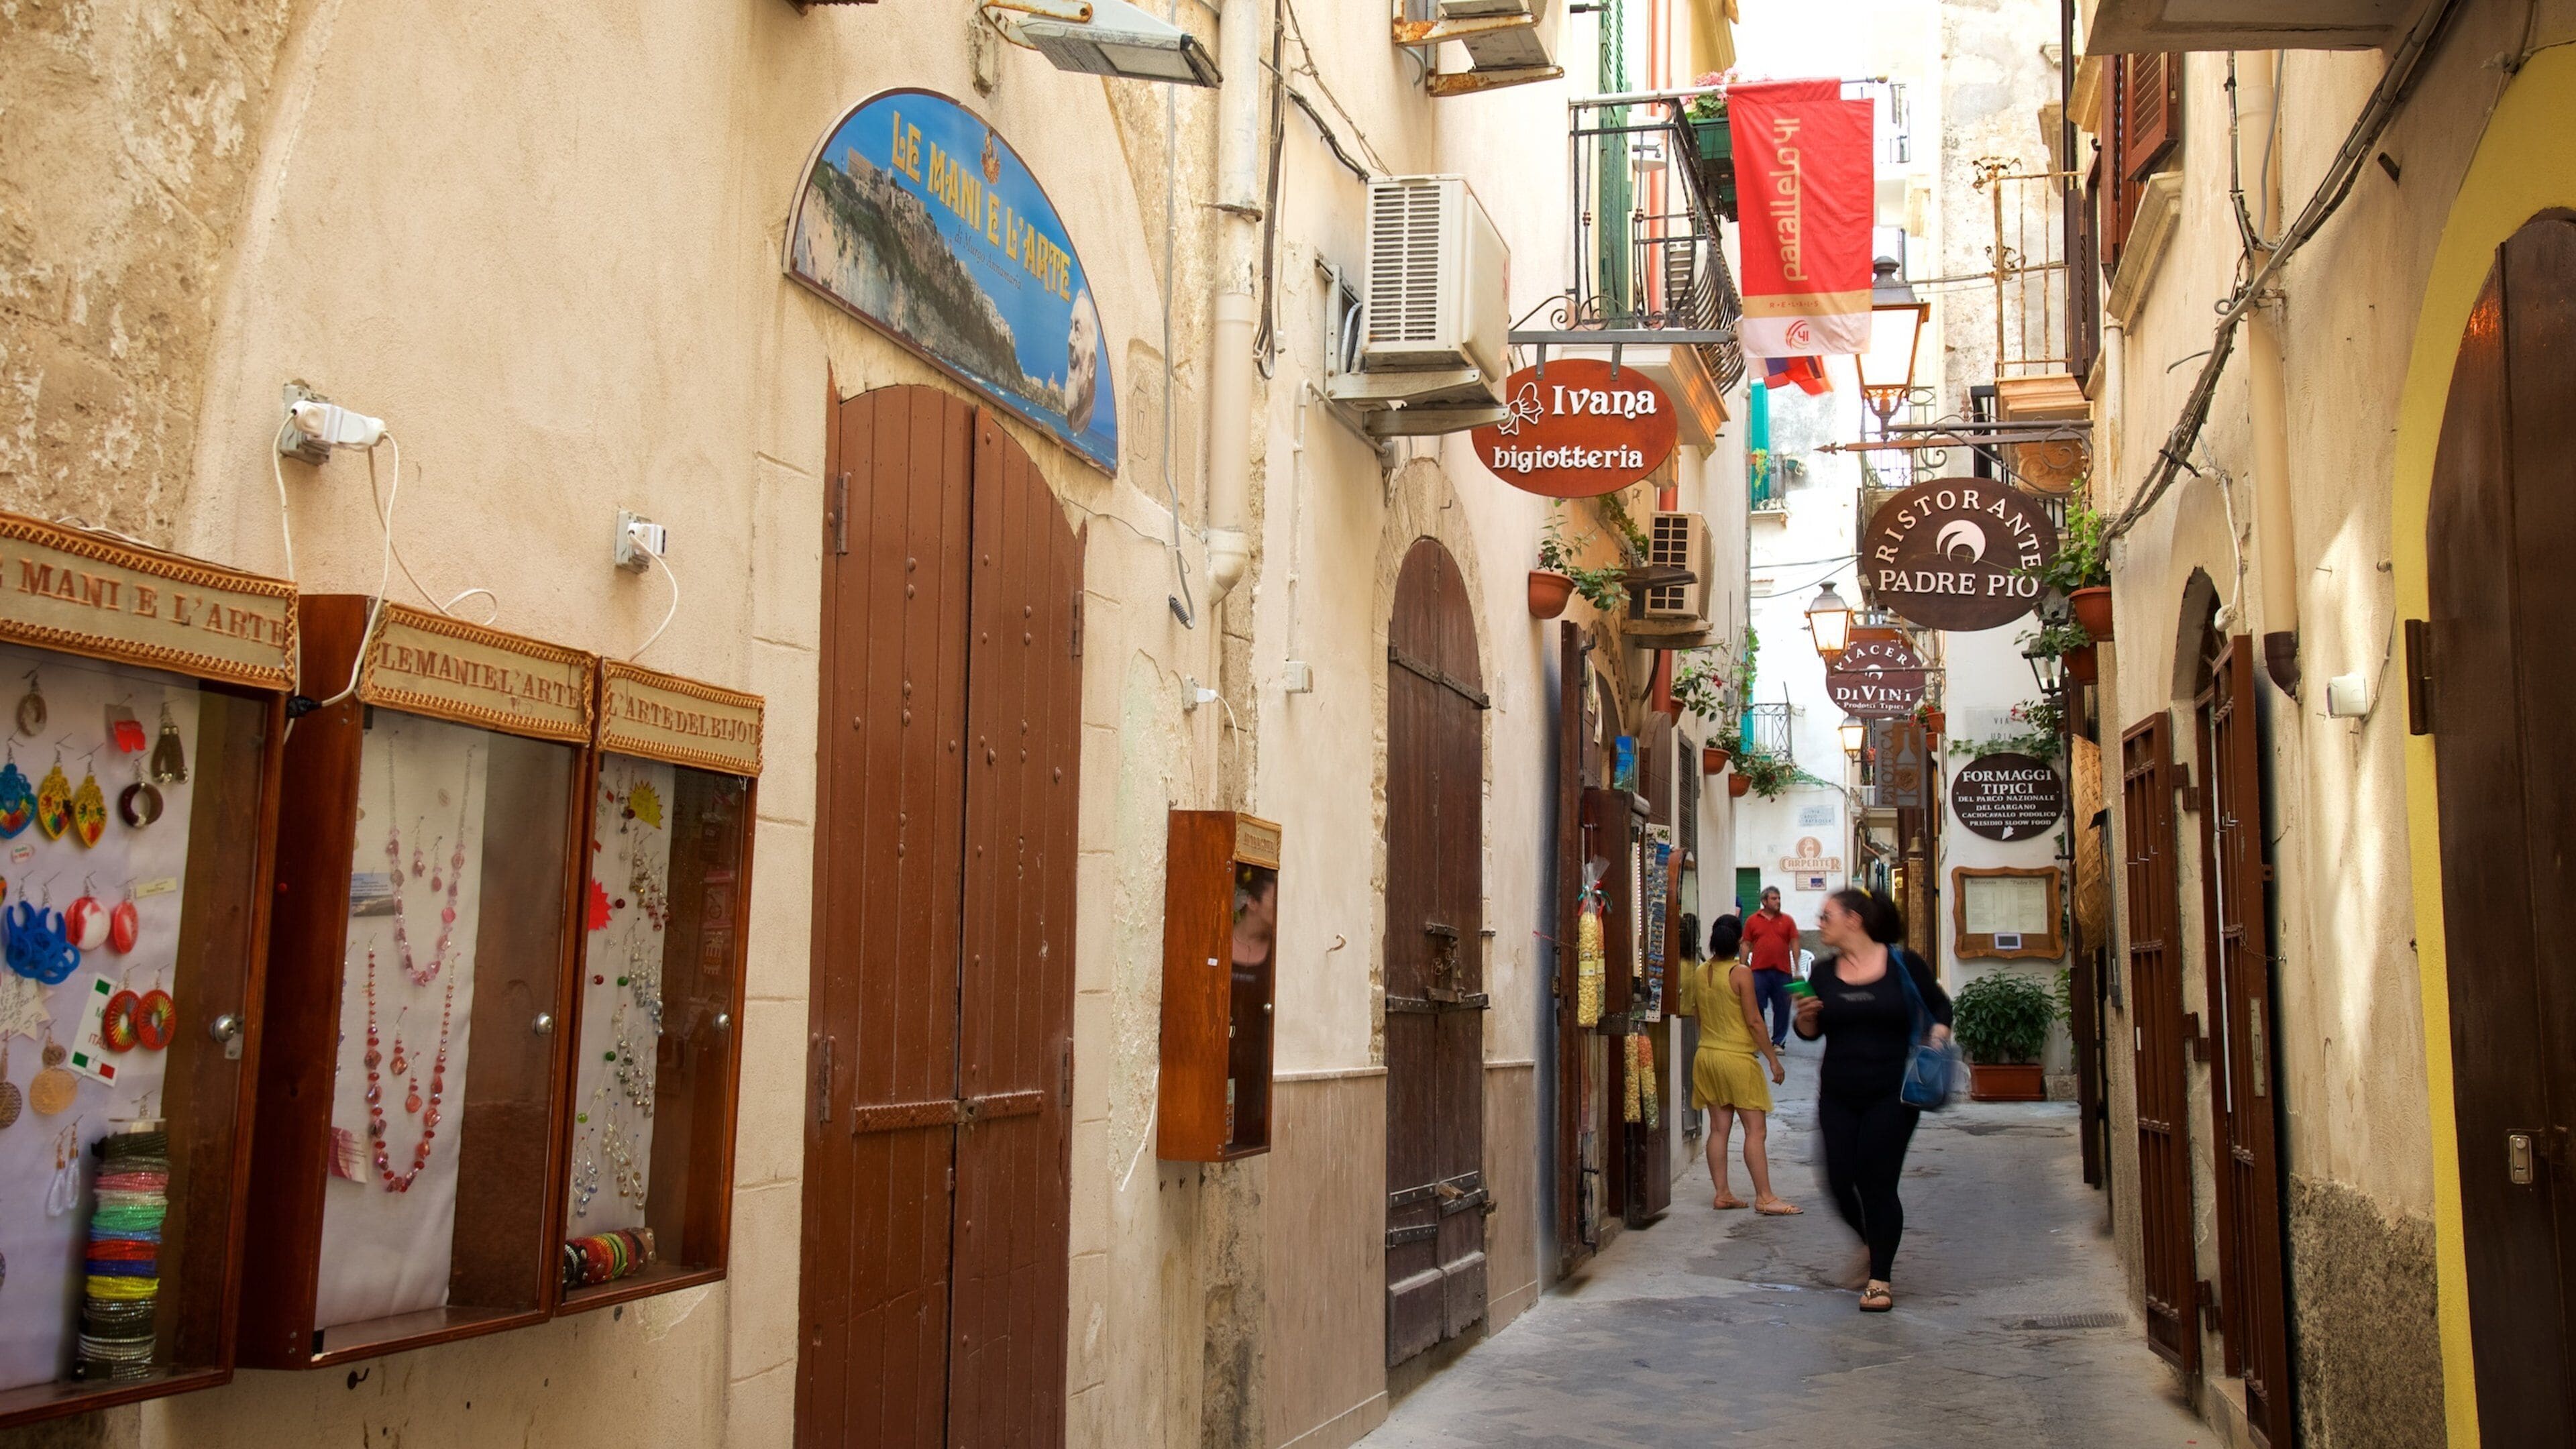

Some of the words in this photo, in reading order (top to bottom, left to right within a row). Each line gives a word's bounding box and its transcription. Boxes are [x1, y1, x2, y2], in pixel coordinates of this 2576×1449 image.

[892, 111, 922, 184] LE
[927, 142, 982, 232] MANI
[986, 191, 1001, 248] E
[1006, 207, 1071, 303] L'ARTE
[955, 225, 963, 244] di
[1552, 385, 1657, 419] Ivana
[1493, 444, 1644, 474] bigiotteria
[1876, 490, 2043, 570] RISTORANTE
[1878, 570, 1976, 595] PADRE
[1987, 574, 2039, 598] PIO
[17, 557, 121, 610] MANI
[133, 584, 159, 619] E
[168, 592, 286, 649] L'ARTE
[1962, 769, 2052, 782] FORMAGGI
[1981, 783, 2034, 795] TIPICI
[1781, 857, 1841, 870] CARPENTER
